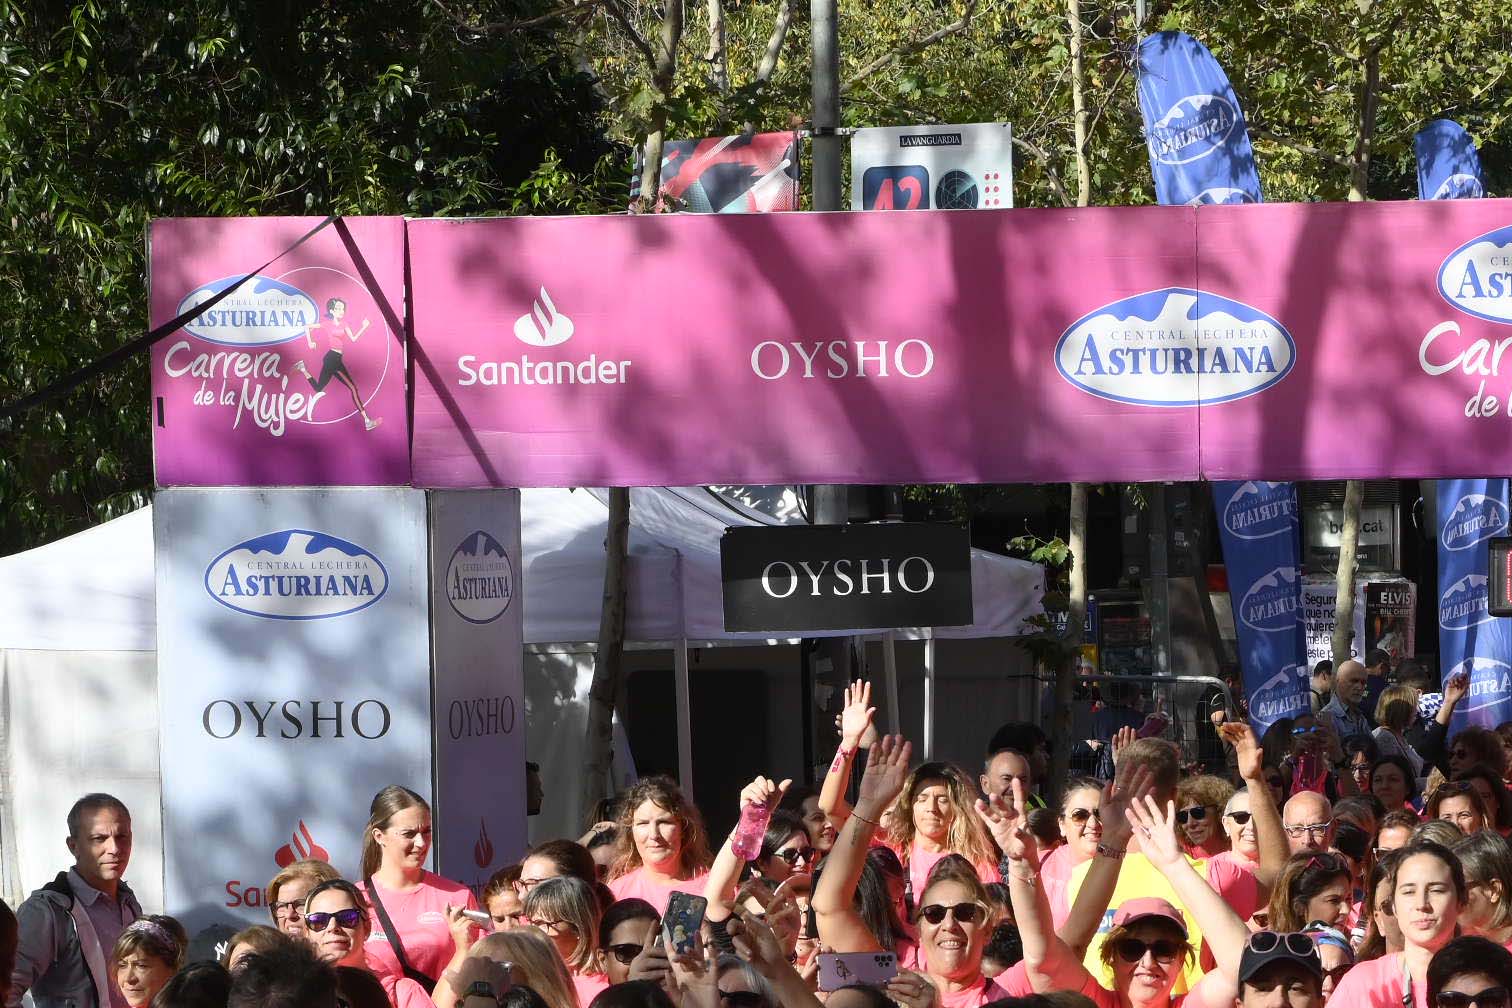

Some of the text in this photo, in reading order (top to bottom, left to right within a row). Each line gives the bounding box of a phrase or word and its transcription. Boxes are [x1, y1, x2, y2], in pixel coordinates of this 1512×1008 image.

[188, 301, 306, 327] ASTURIANA
[1110, 328, 1270, 340] CENTRAL LECHERA
[165, 341, 281, 379] Carrera
[458, 353, 631, 386] Santander
[751, 338, 935, 380] OYSHO
[1075, 333, 1277, 376] ASTURIANA
[193, 376, 326, 437] de la Mujer
[1465, 380, 1500, 418] de
[220, 564, 376, 598] ASTURIANA
[247, 561, 369, 570] CENTRAL LECHERA
[452, 566, 510, 600] ASTURIANA
[762, 555, 935, 599] OYSHO
[1305, 609, 1323, 620] que
[1307, 648, 1325, 659] este
[203, 698, 392, 740] OYSHO
[449, 695, 515, 739] OYSHO
